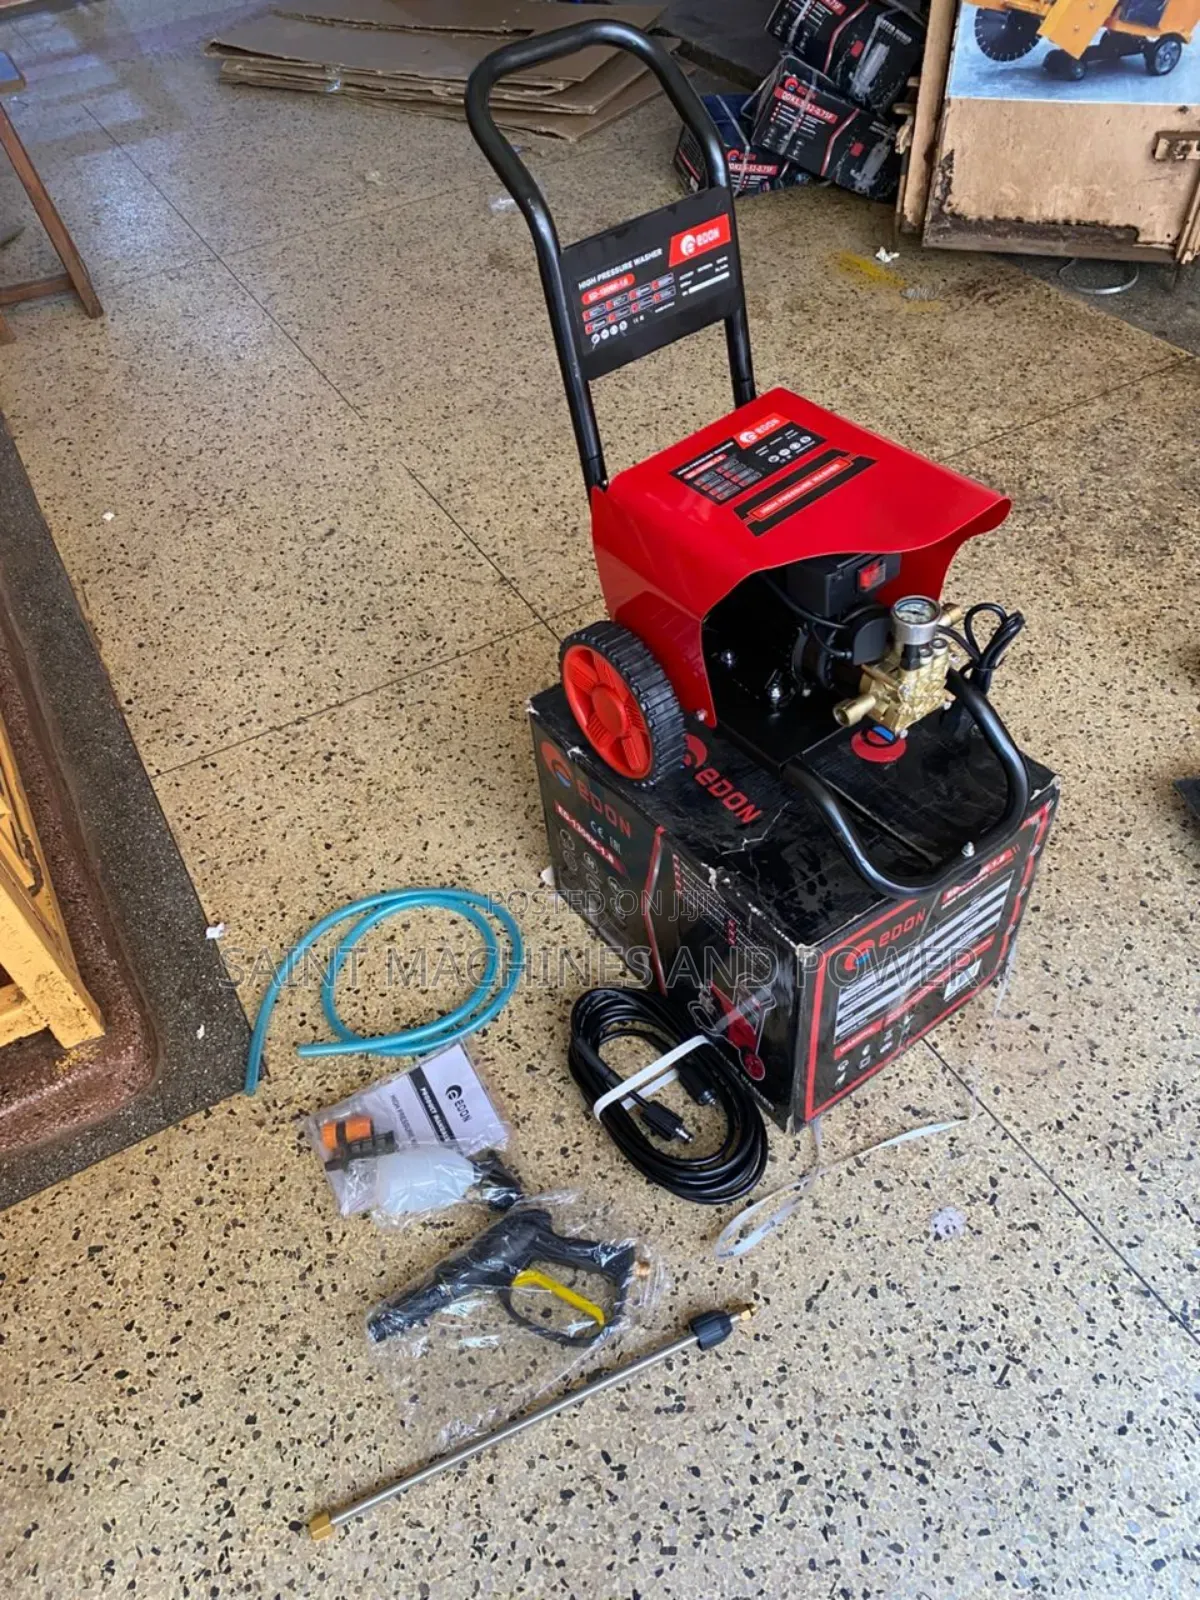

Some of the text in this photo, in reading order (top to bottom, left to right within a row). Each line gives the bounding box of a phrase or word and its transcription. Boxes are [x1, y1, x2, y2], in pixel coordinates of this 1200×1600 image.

[695, 227, 720, 247] EDON
[578, 248, 663, 291] HIGH PRESSURE WASHER
[754, 417, 780, 434] EDON
[576, 779, 632, 838] EDON
[695, 767, 763, 824] EDON
[879, 908, 926, 947] EDON
[390, 1094, 414, 1139] HIGH PRESSURE
[420, 1086, 436, 1118] PRODUCT
[454, 1098, 473, 1123] EDON
